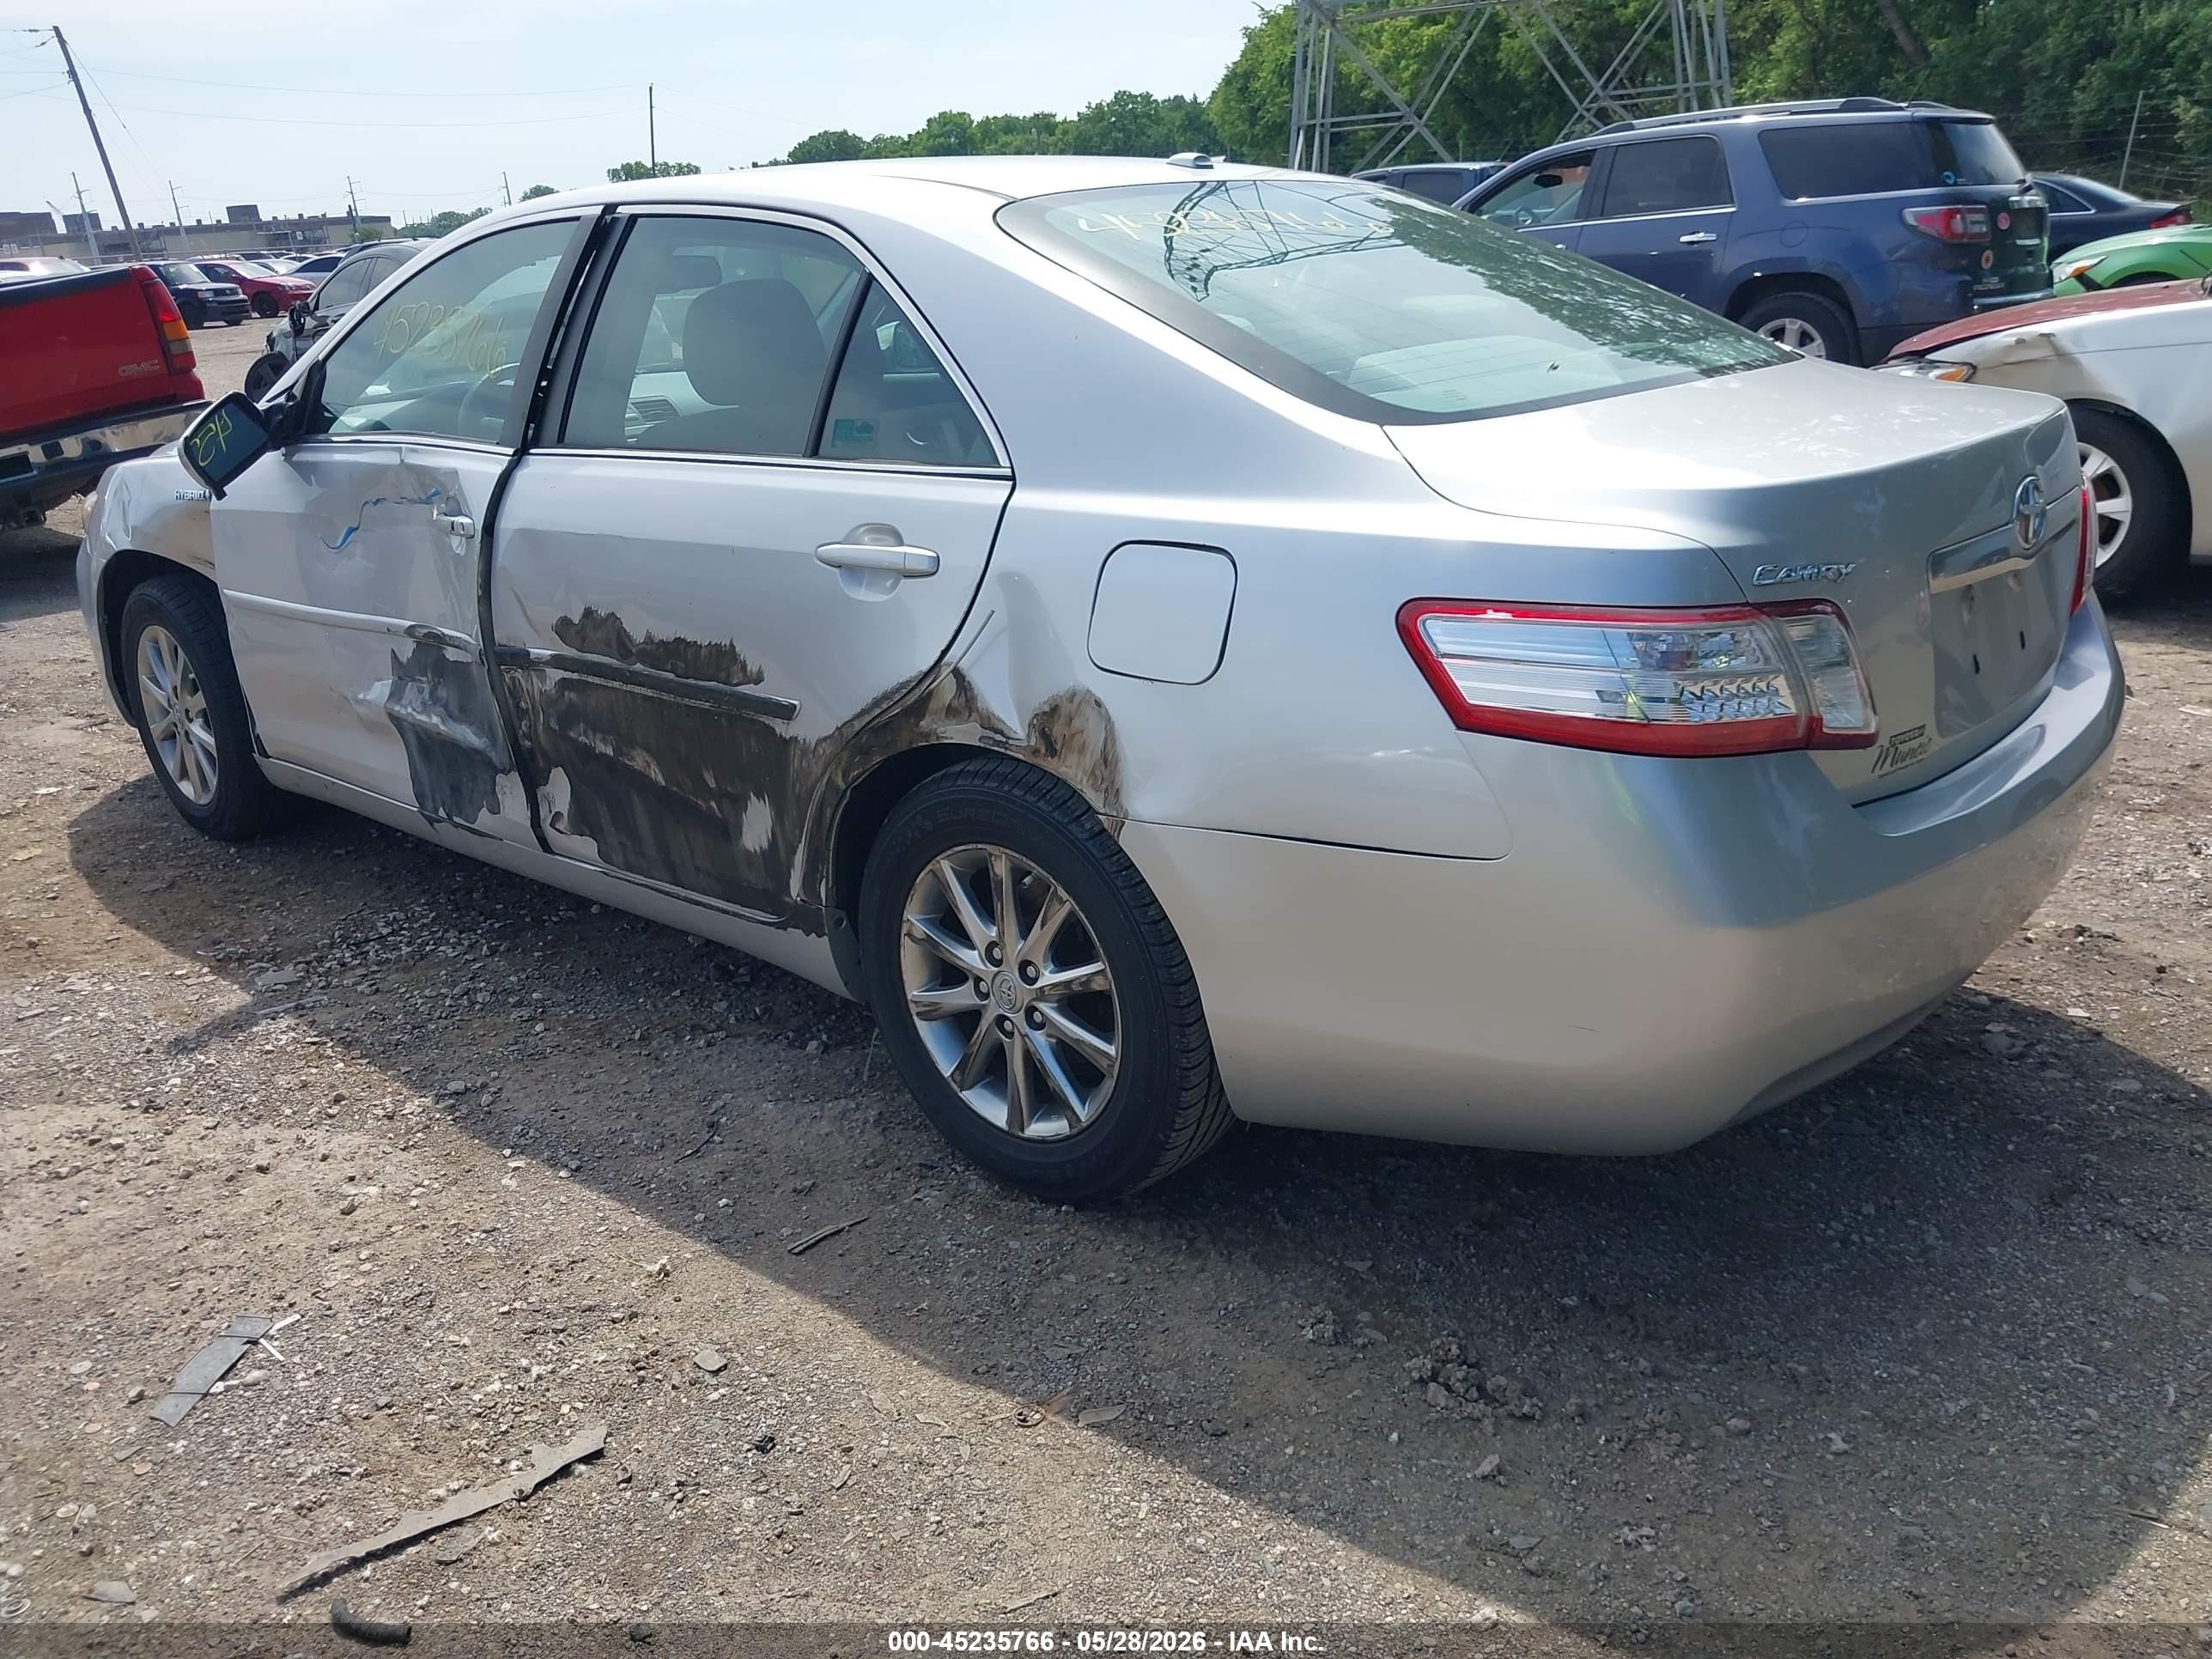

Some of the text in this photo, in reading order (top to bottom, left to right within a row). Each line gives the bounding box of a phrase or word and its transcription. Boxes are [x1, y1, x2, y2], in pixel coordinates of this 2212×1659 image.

[118, 359, 161, 378] GMC
[174, 489, 204, 501] HYBRID
[1752, 563, 1856, 586] CAMRY
